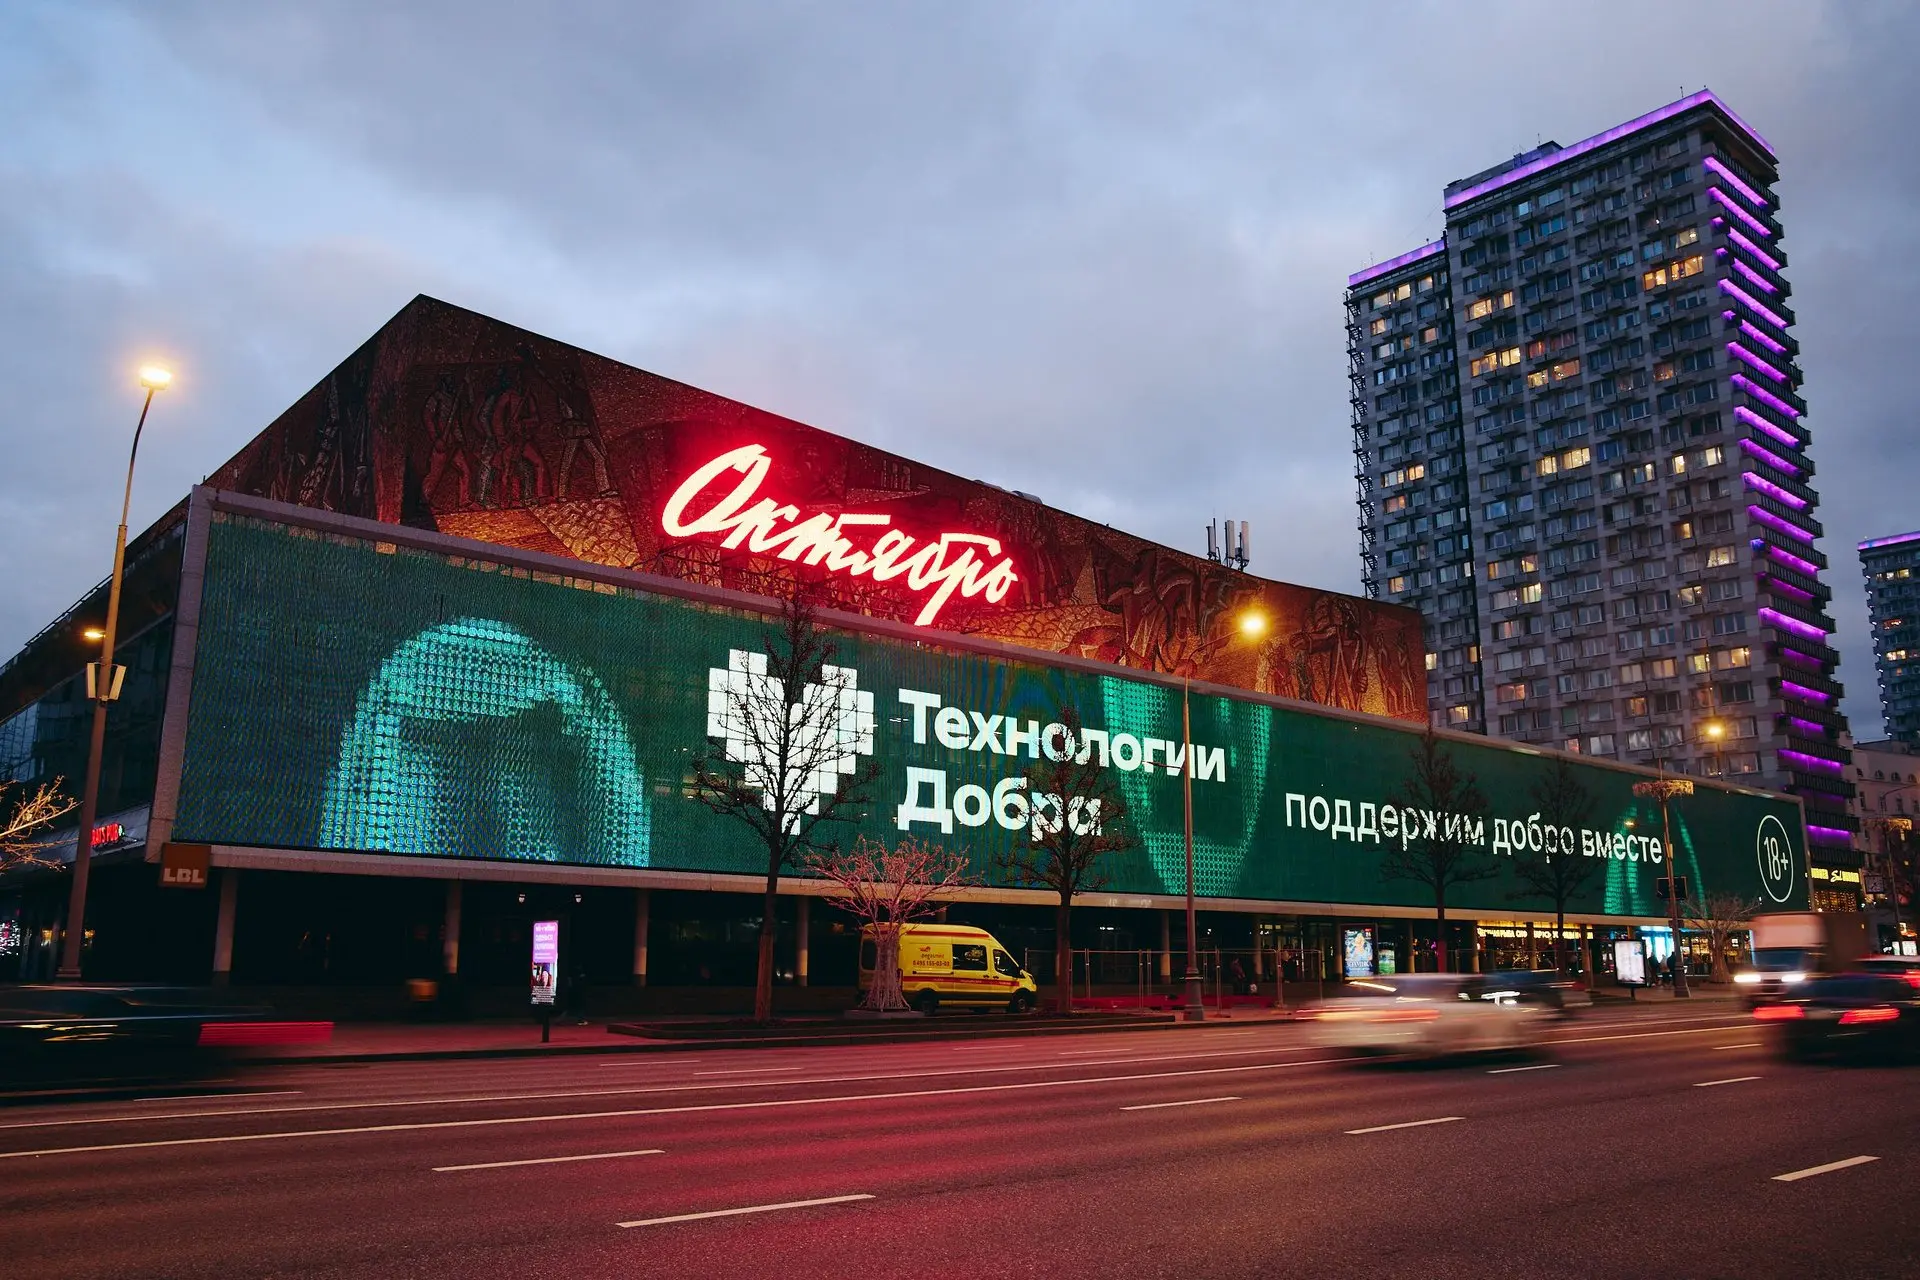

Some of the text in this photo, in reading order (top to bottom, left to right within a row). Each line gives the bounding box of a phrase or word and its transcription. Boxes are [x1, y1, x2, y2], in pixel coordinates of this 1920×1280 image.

[662, 443, 1018, 626] Октябрь
[898, 688, 1226, 783] Технологии
[897, 766, 1102, 842] Добра
[1285, 792, 1663, 865] поддержим добро вместе
[162, 867, 205, 883] LBL
[1763, 836, 1789, 881] 18+
